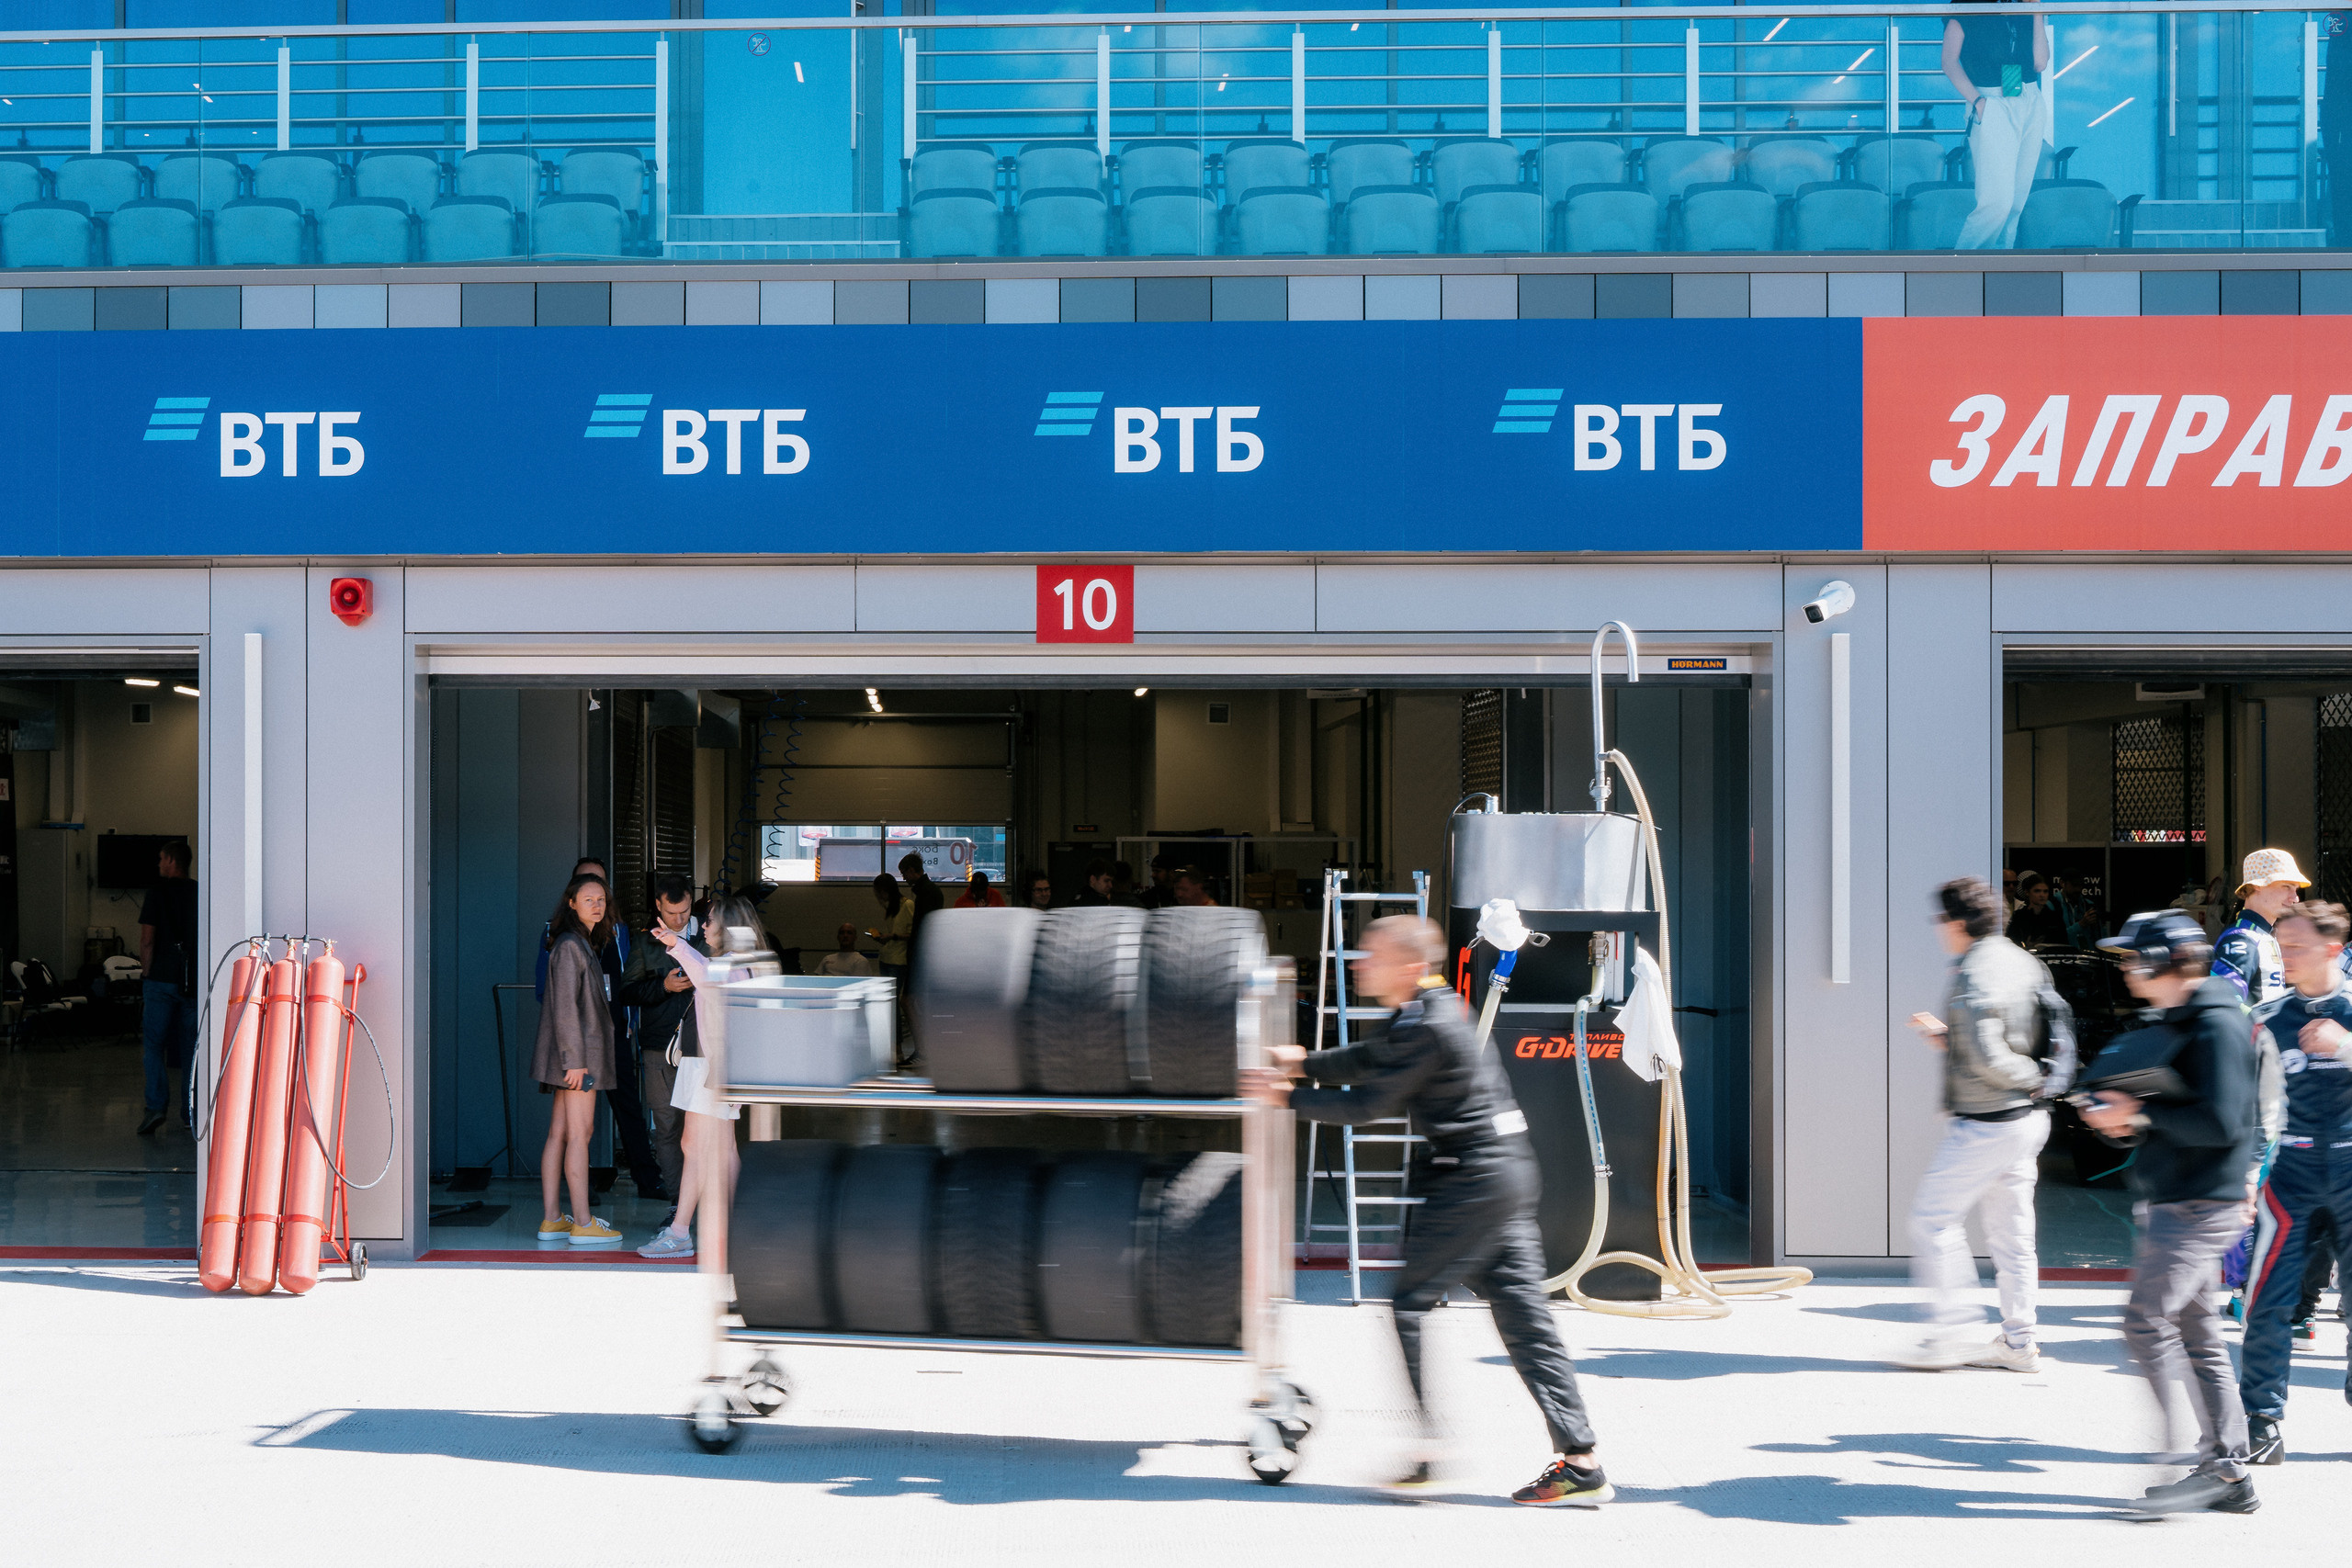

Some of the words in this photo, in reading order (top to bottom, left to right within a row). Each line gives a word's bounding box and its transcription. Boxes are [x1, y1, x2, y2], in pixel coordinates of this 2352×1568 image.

[220, 412, 365, 478] ВТБ
[662, 409, 810, 475] ВТБ
[1114, 407, 1264, 473] ВТБ
[1574, 404, 1727, 471] ВТБ
[1929, 394, 2352, 488] ЗАПРАВ
[1053, 578, 1117, 631] 10
[2222, 941, 2248, 955] 12
[1515, 1036, 1623, 1059] G-DRVE
[1569, 1032, 1625, 1041] ТПЛИВО
